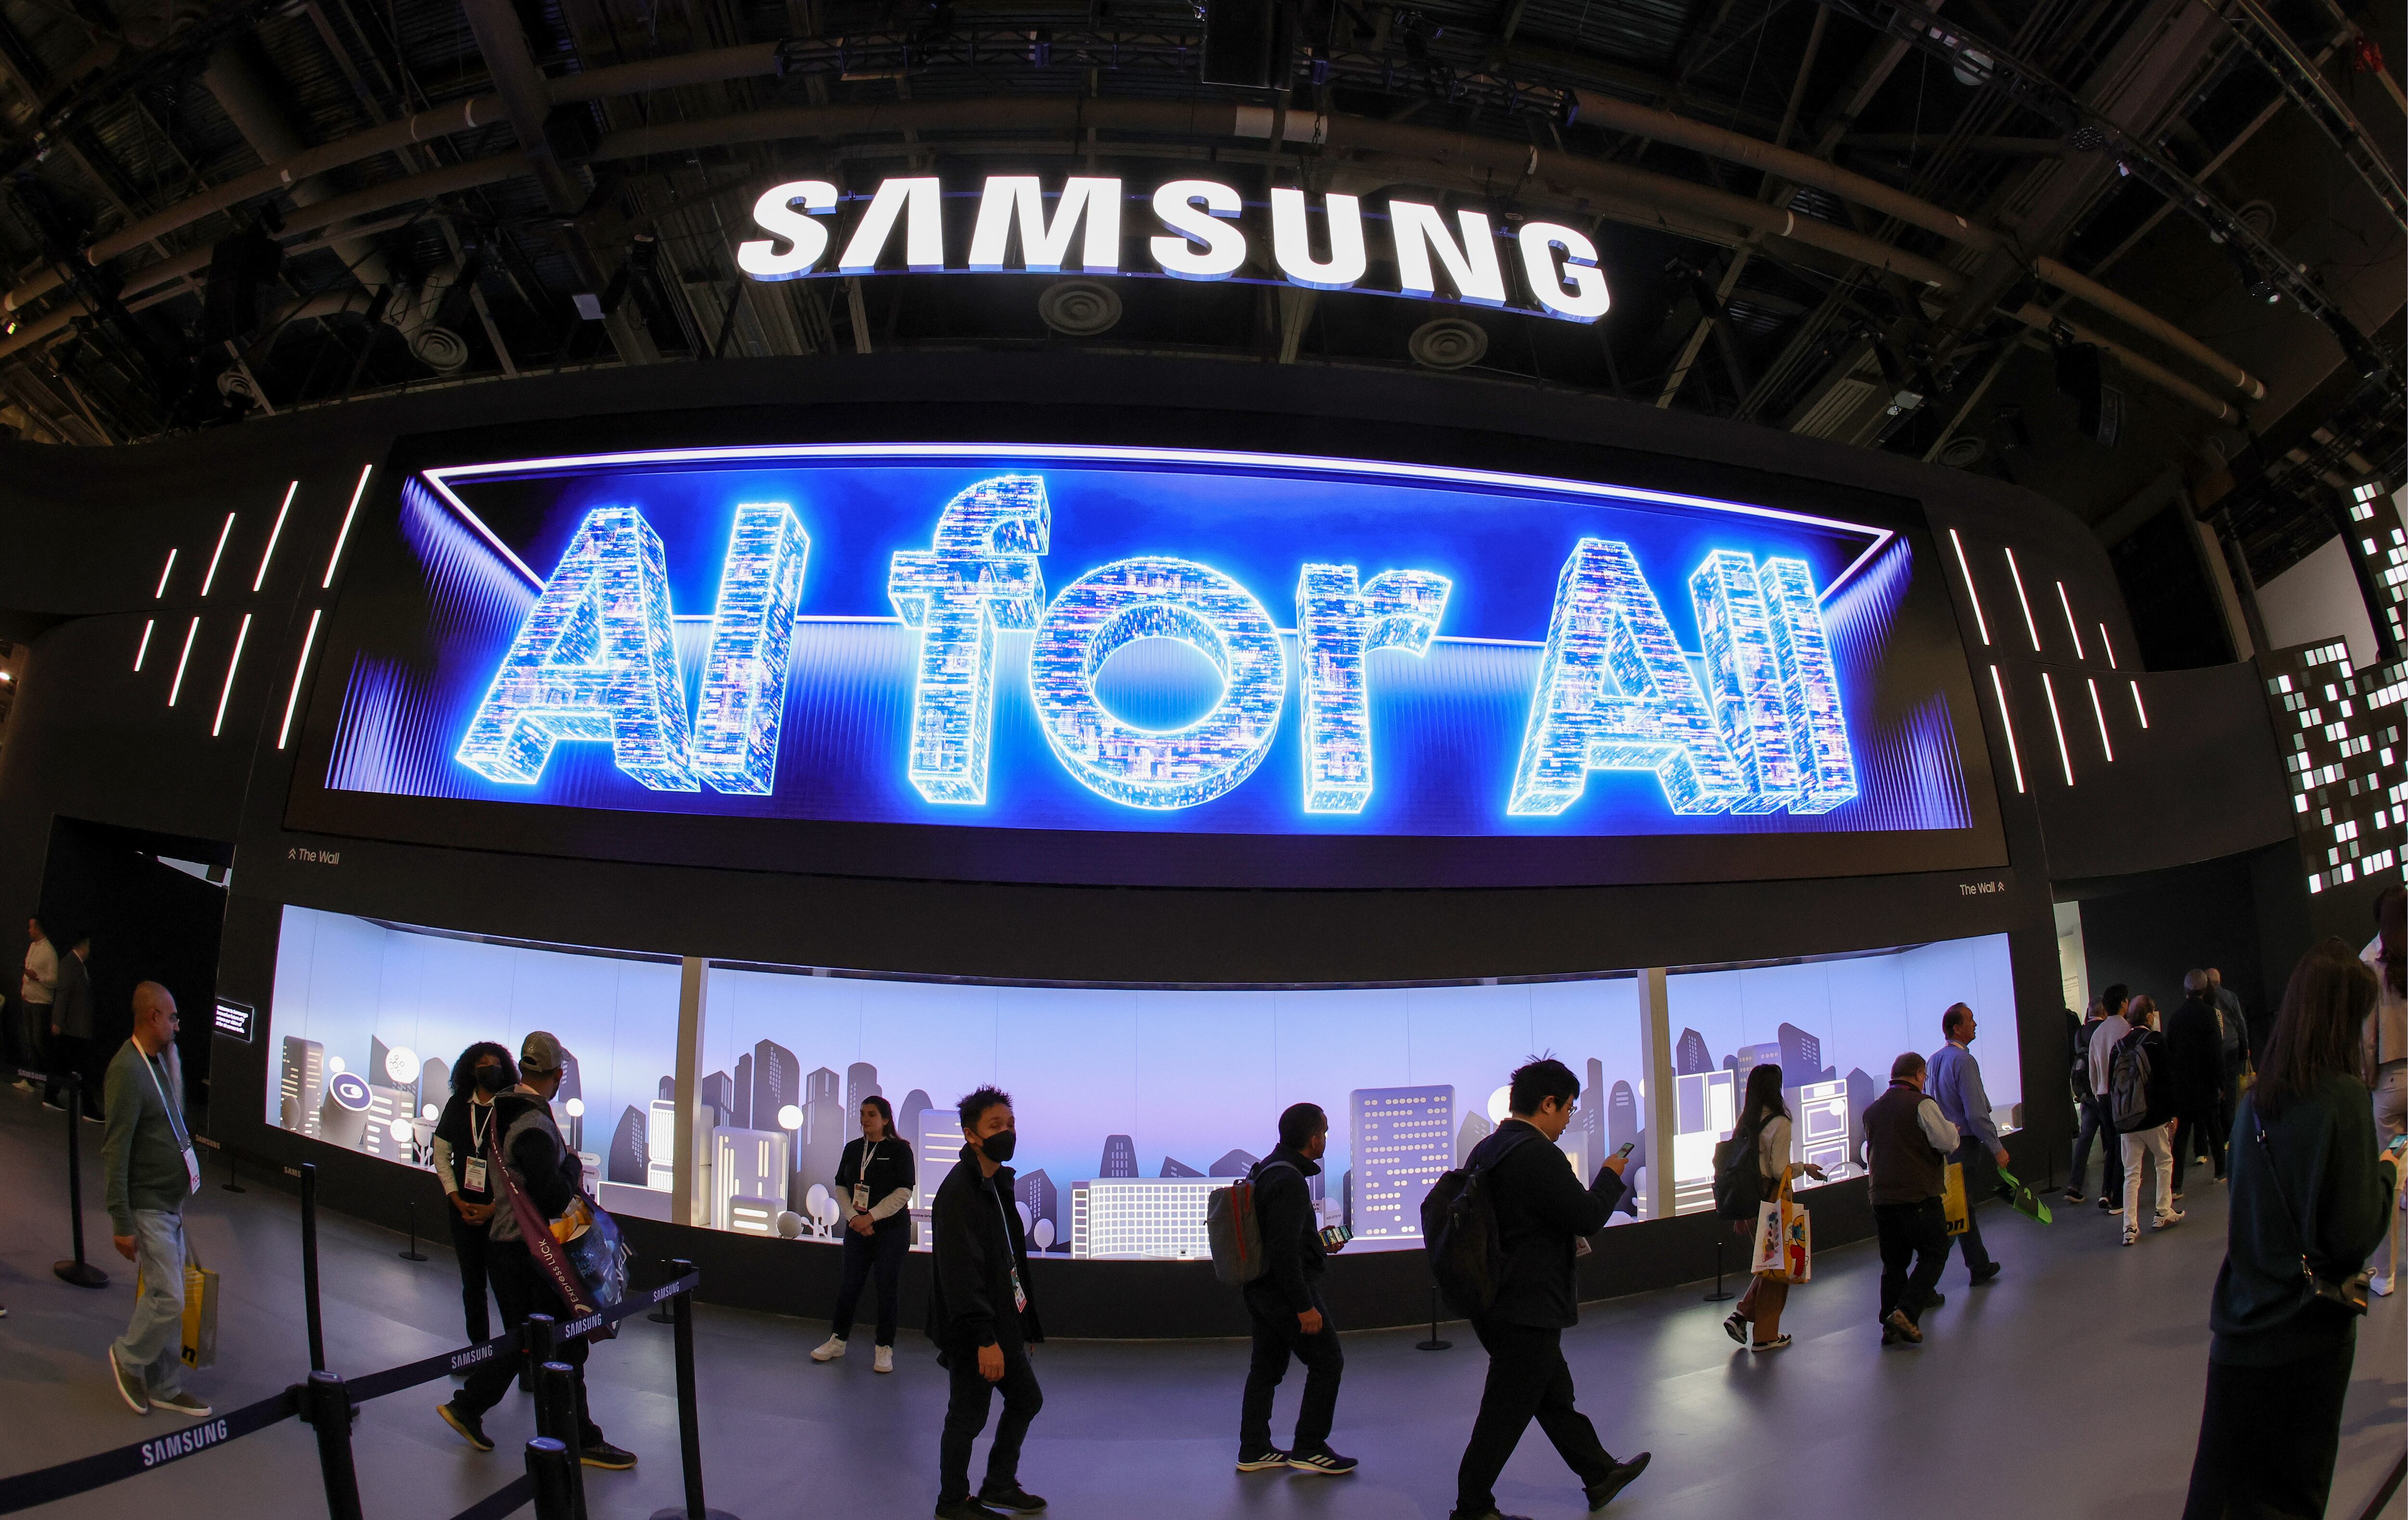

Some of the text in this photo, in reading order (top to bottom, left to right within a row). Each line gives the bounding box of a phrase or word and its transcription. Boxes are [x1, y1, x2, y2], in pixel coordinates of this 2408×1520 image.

[737, 176, 1611, 324] SAMSUNG
[456, 474, 1858, 815] AI for All
[299, 848, 340, 865] The Wall
[1959, 881, 1996, 896] The Wall
[284, 1166, 301, 1179] SAMS
[538, 1238, 579, 1303] Express LUCK
[653, 1281, 680, 1302] SAMSUNG
[565, 1312, 602, 1338] SAMSUNG
[451, 1344, 493, 1369] SAMSUNG
[142, 1419, 227, 1467] SAMSUNG
